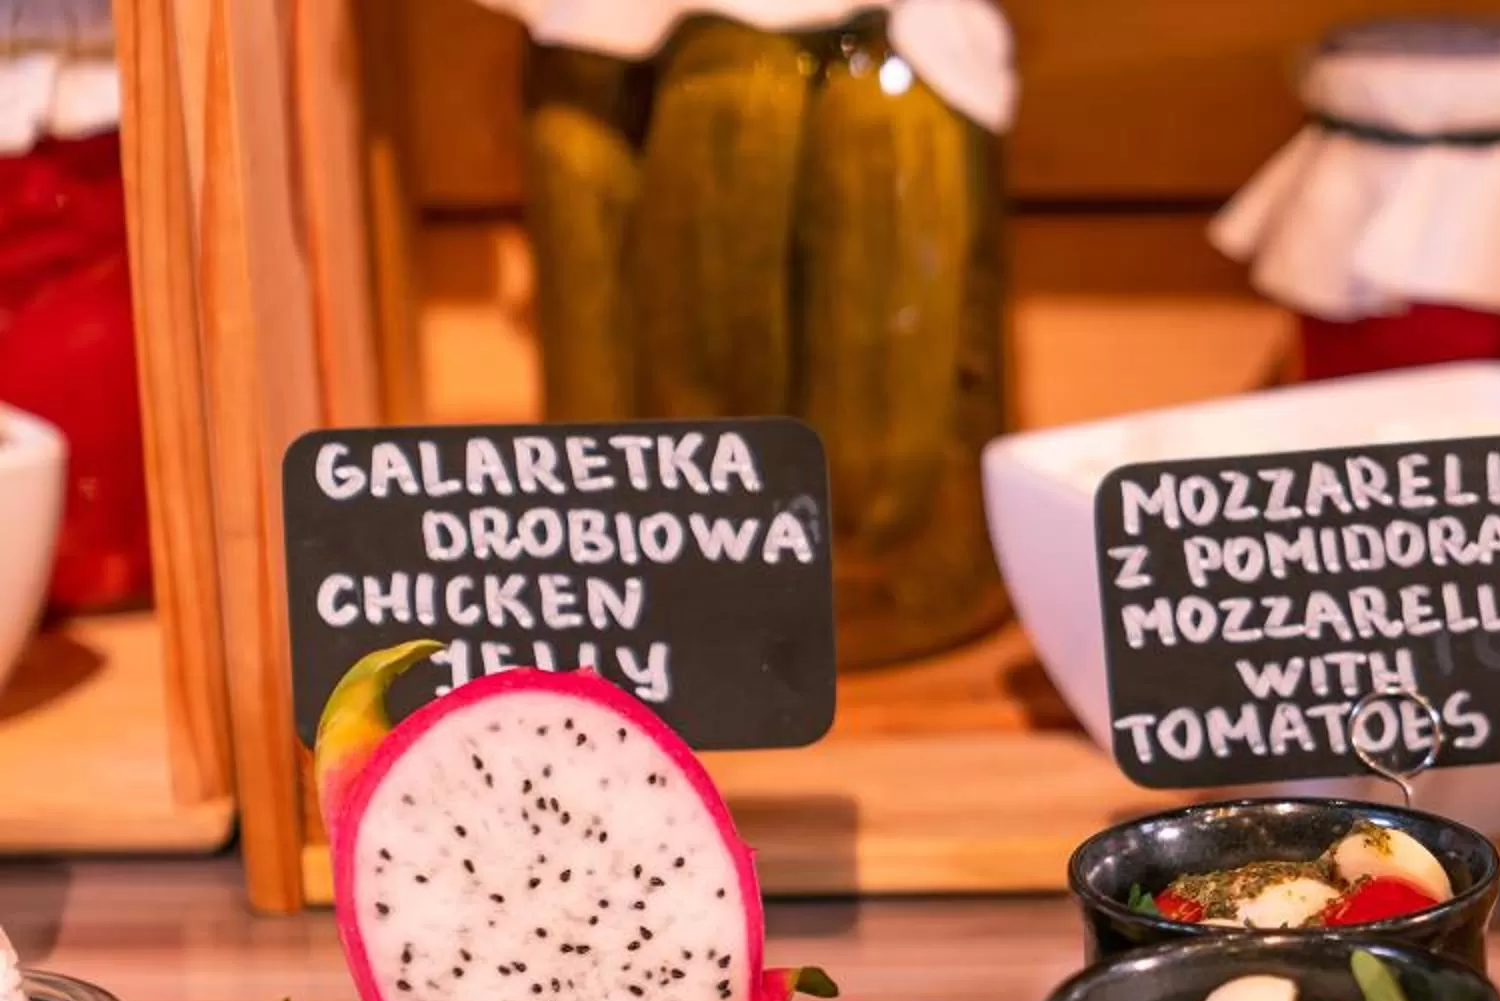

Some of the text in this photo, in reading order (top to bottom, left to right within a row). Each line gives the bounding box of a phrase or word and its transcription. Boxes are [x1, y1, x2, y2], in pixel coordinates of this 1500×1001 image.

[314, 432, 762, 499] GALARETKA
[420, 507, 814, 565] DROBIOWA
[315, 572, 645, 630] CHICKEN
[1236, 648, 1418, 700] WITH
[1114, 690, 1491, 764] TOMATOES
